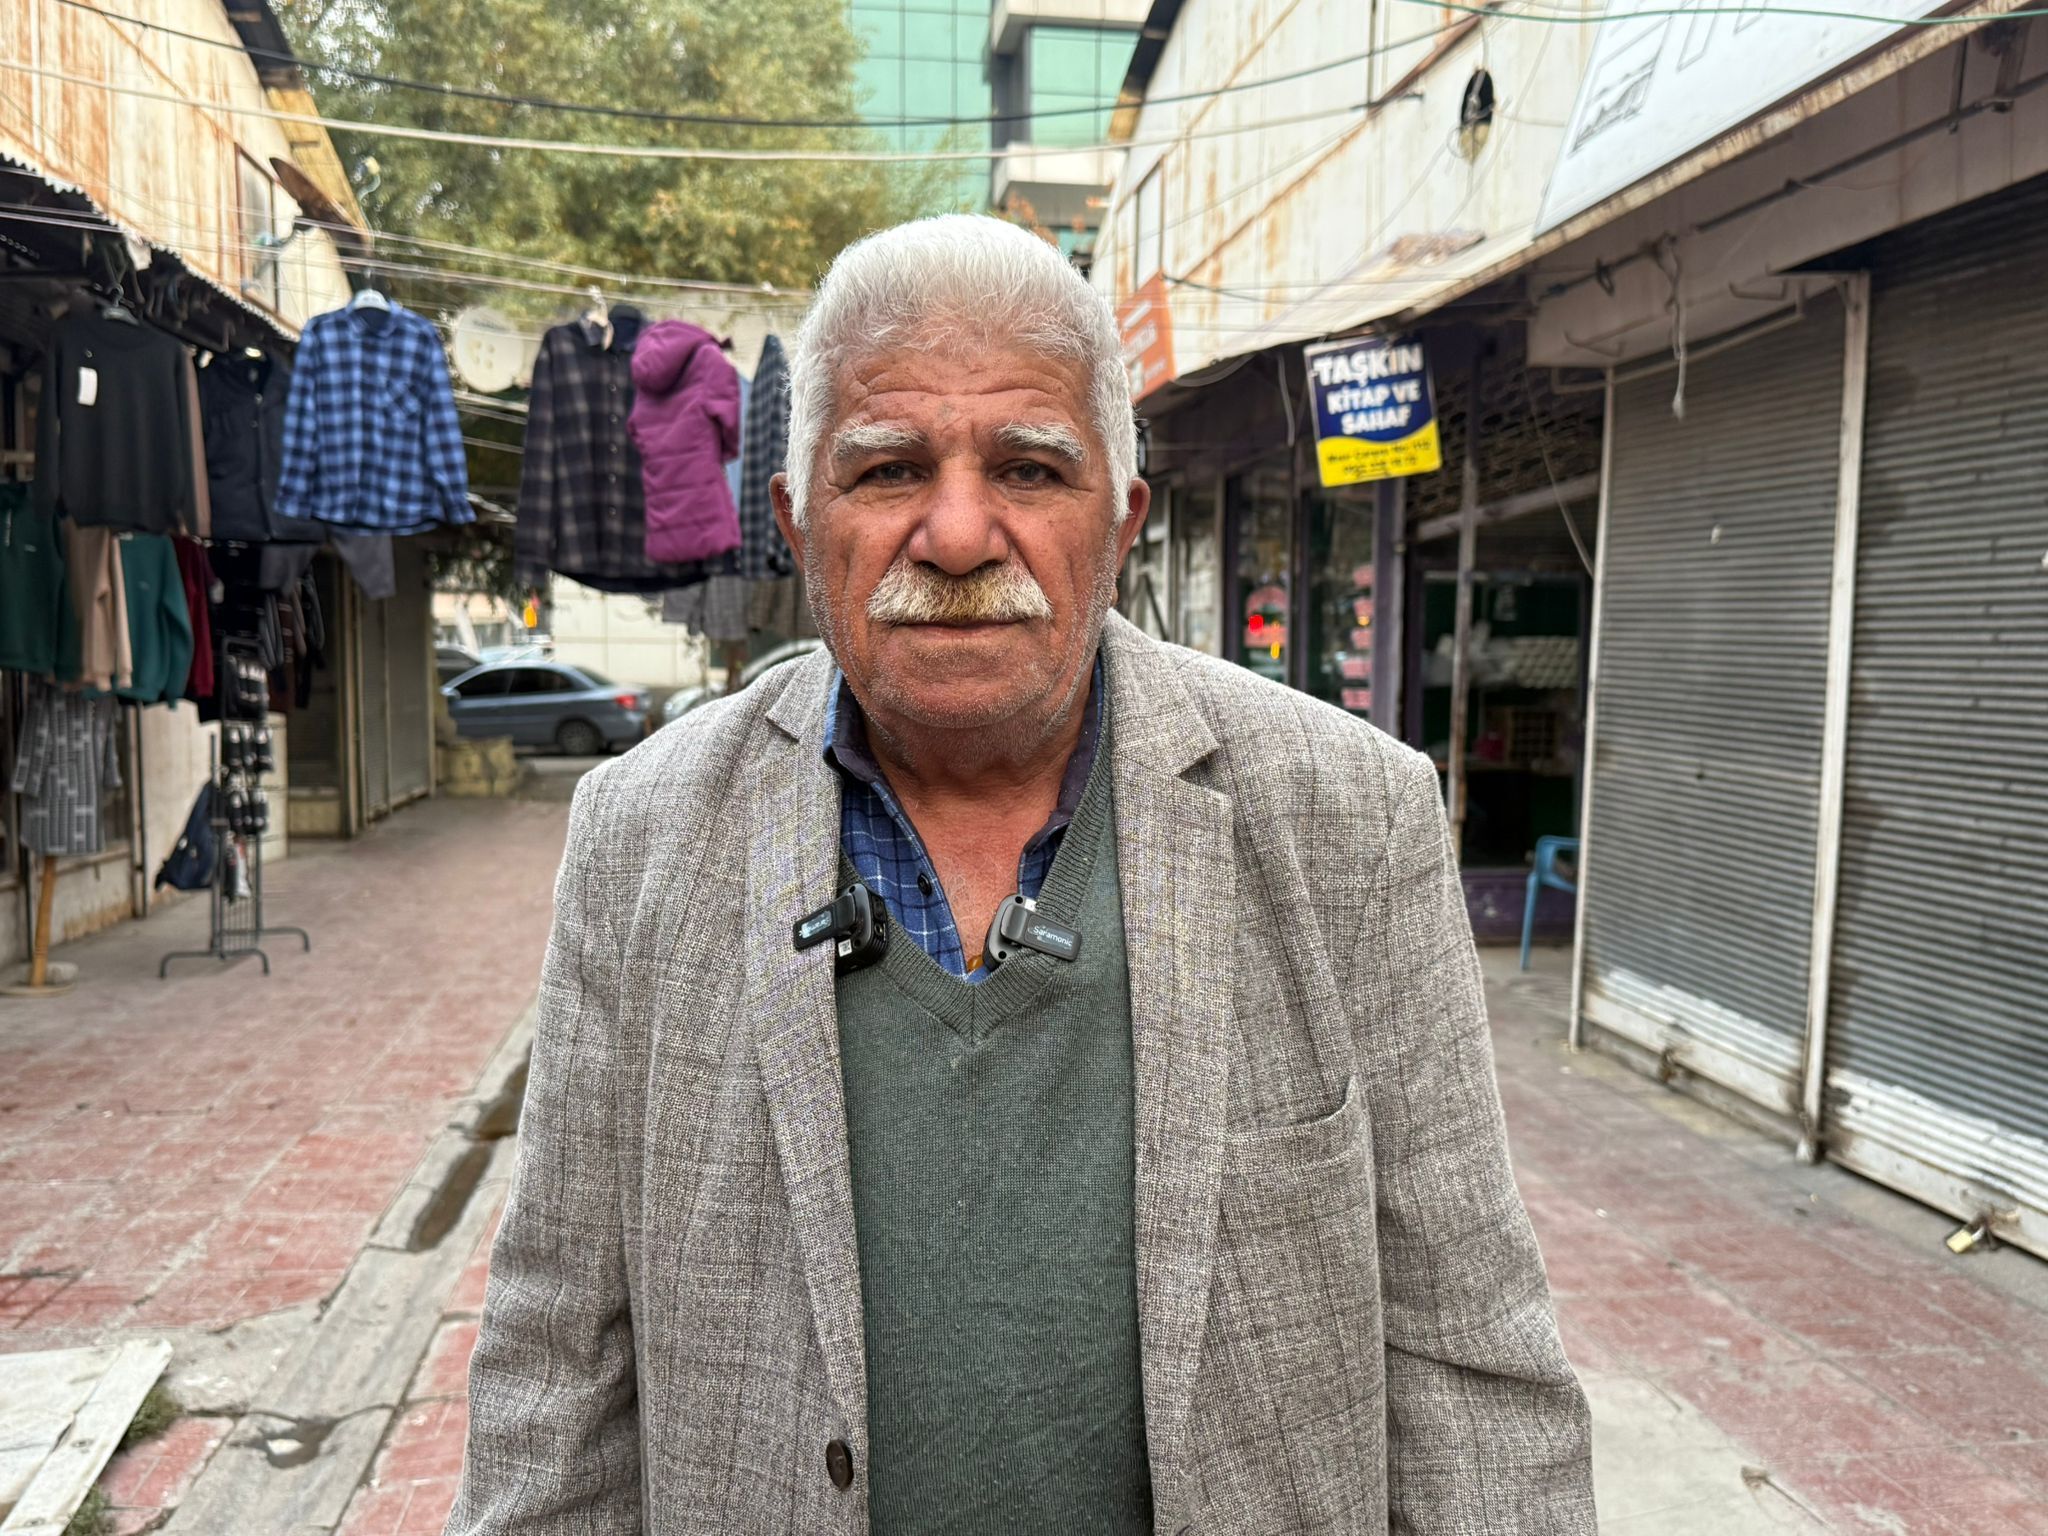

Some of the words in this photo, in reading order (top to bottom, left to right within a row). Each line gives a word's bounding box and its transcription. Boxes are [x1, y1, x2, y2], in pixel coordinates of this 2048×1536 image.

[1313, 345, 1423, 386] TAŞKIN
[1327, 385, 1390, 414] KİTAP
[1392, 380, 1421, 402] VE
[1342, 405, 1411, 434] SAHAF
[1033, 925, 1073, 947] Saramonic
